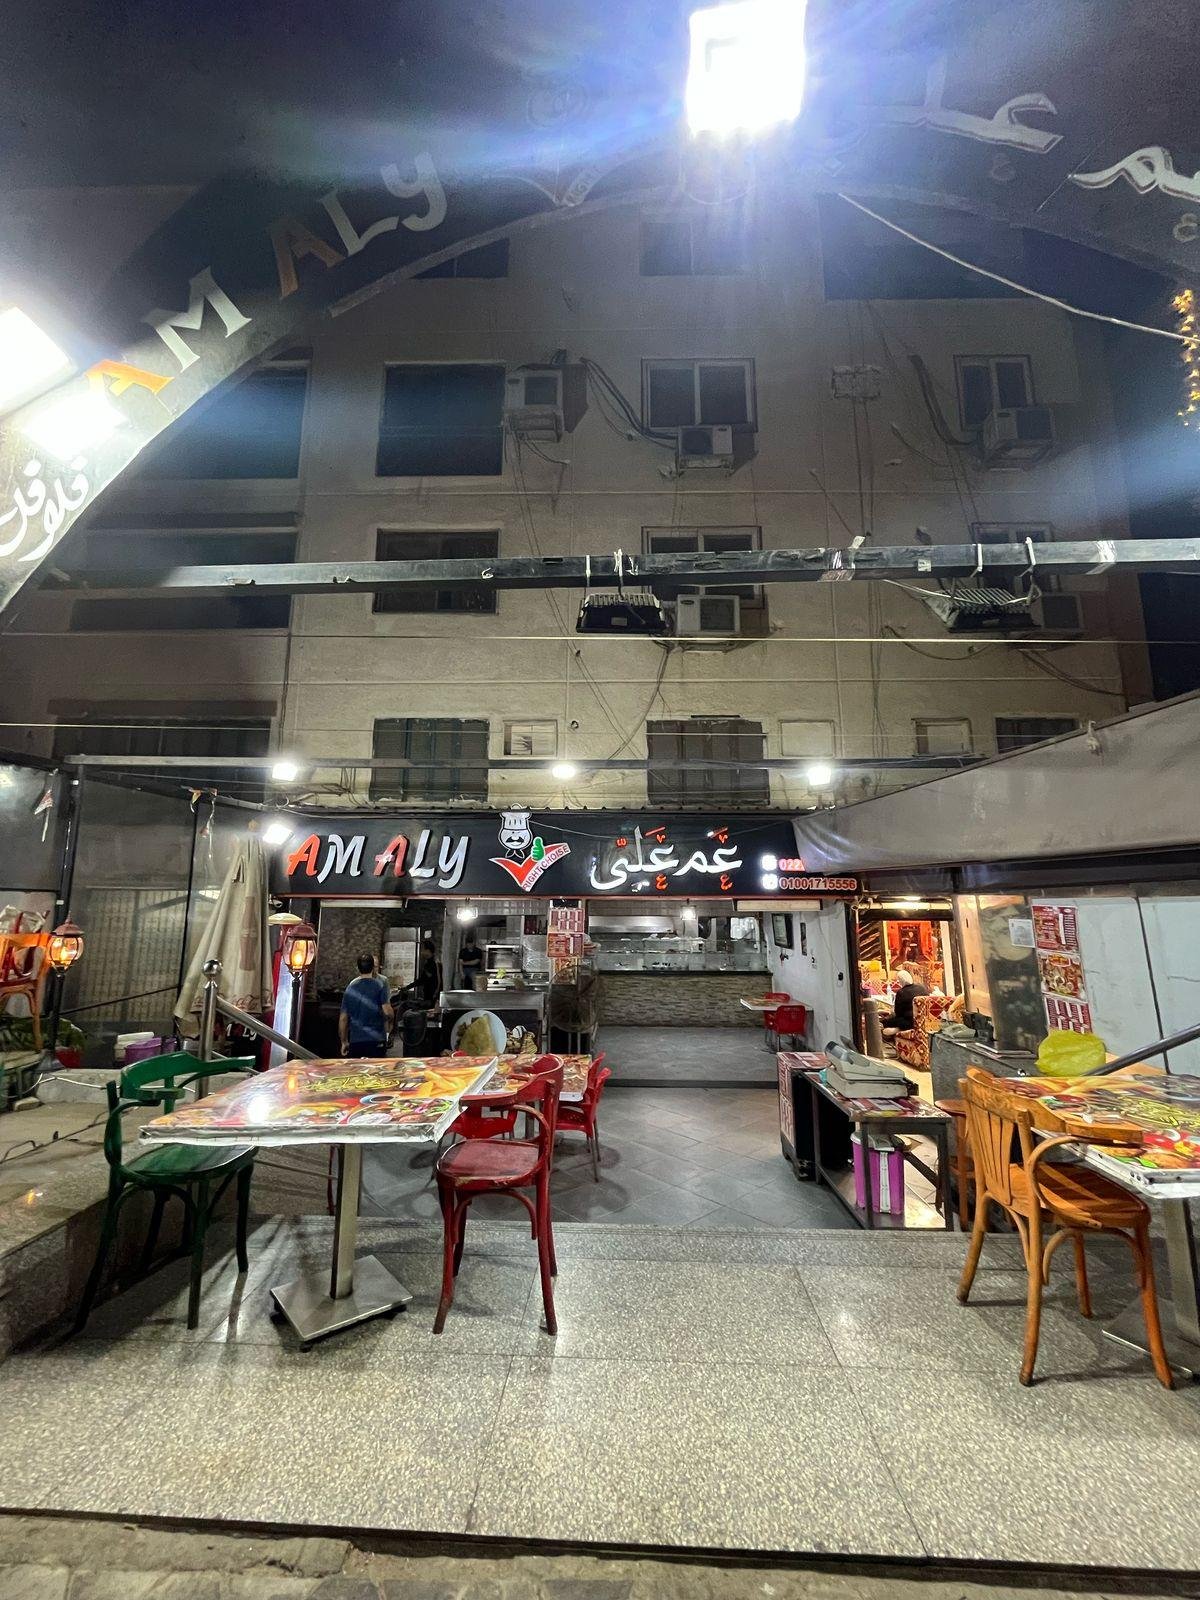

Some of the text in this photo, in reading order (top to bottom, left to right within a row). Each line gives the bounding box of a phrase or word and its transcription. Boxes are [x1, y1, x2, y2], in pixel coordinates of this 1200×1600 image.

[1069, 145, 1200, 204] م
[86, 266, 252, 396] AM
[286, 829, 469, 889] AM ALY
[522, 845, 570, 891] RIGHT CHOISE
[780, 877, 857, 890] 01001715556
